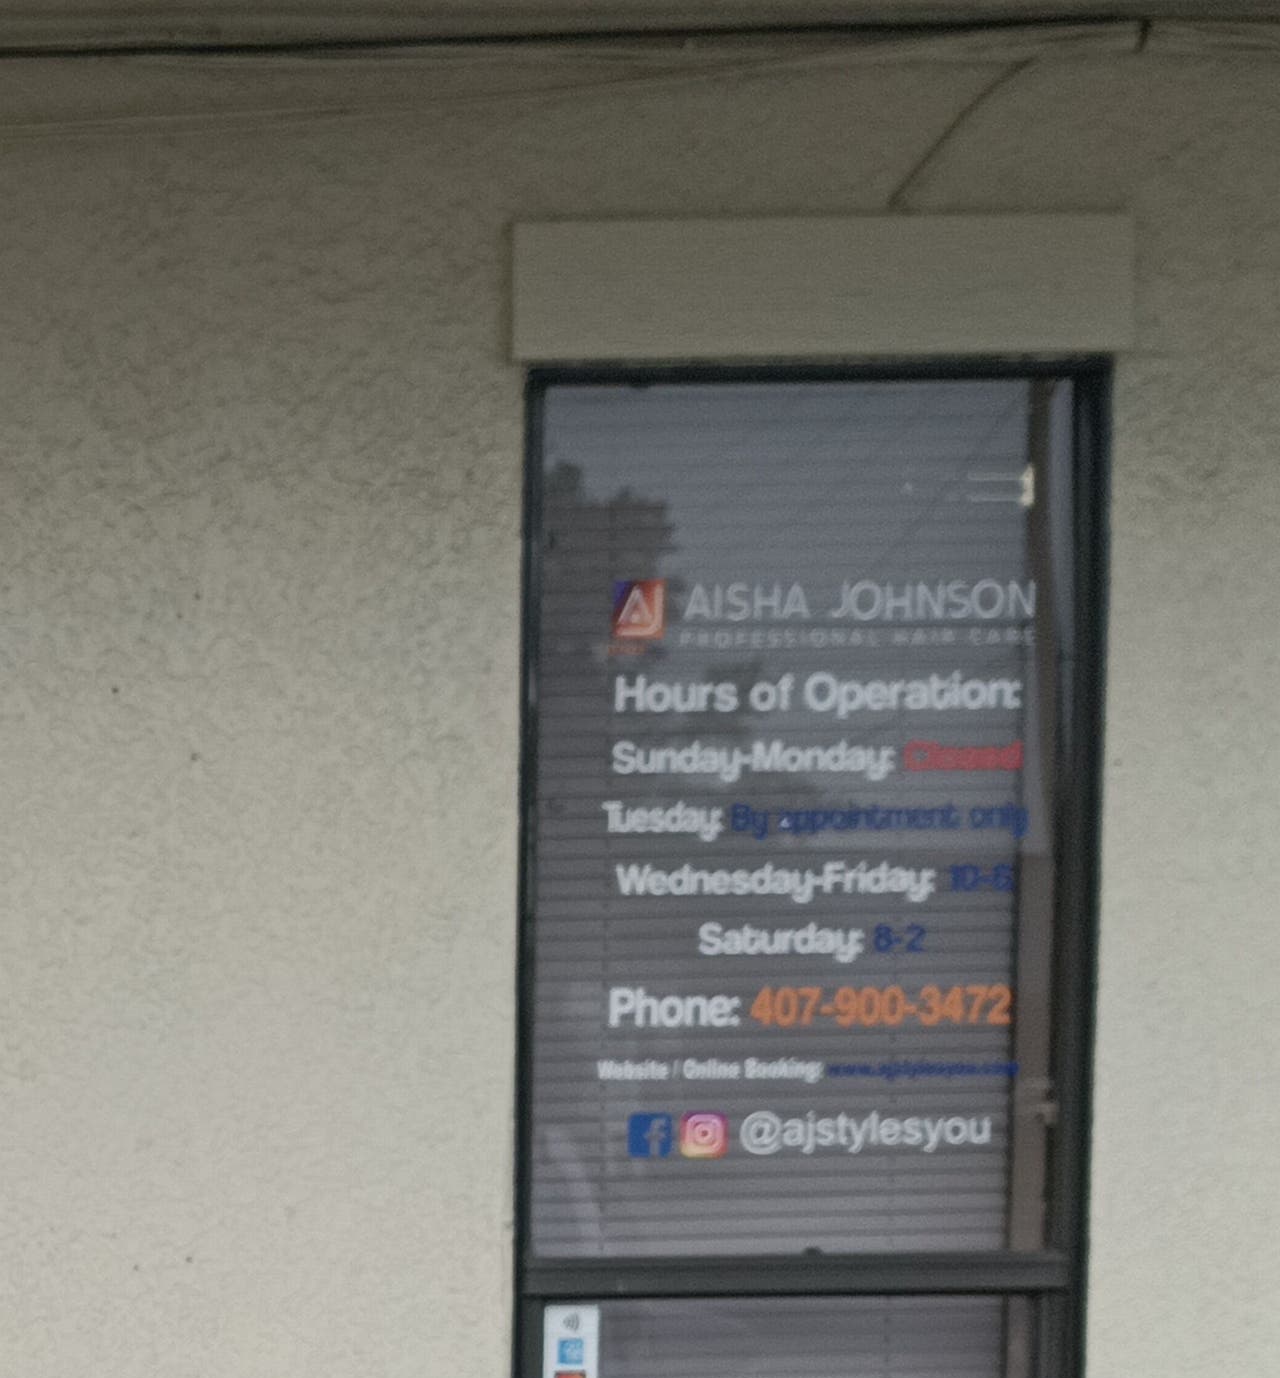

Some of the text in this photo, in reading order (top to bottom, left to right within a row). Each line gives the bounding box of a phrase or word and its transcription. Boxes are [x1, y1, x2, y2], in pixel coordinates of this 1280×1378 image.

[683, 579, 1037, 621] AISHA JOHNSON
[614, 671, 1022, 718] Hours of Operation:
[611, 740, 896, 782] Sunday-Monday:
[601, 801, 723, 842] Tuesday:
[731, 803, 768, 840] By
[616, 860, 936, 904] Wednesday-Friday:
[698, 922, 927, 963] Saturday: 8-2
[608, 984, 1012, 1028] Phone: 407-900-3472
[740, 1110, 992, 1155] @ajstylesyou
